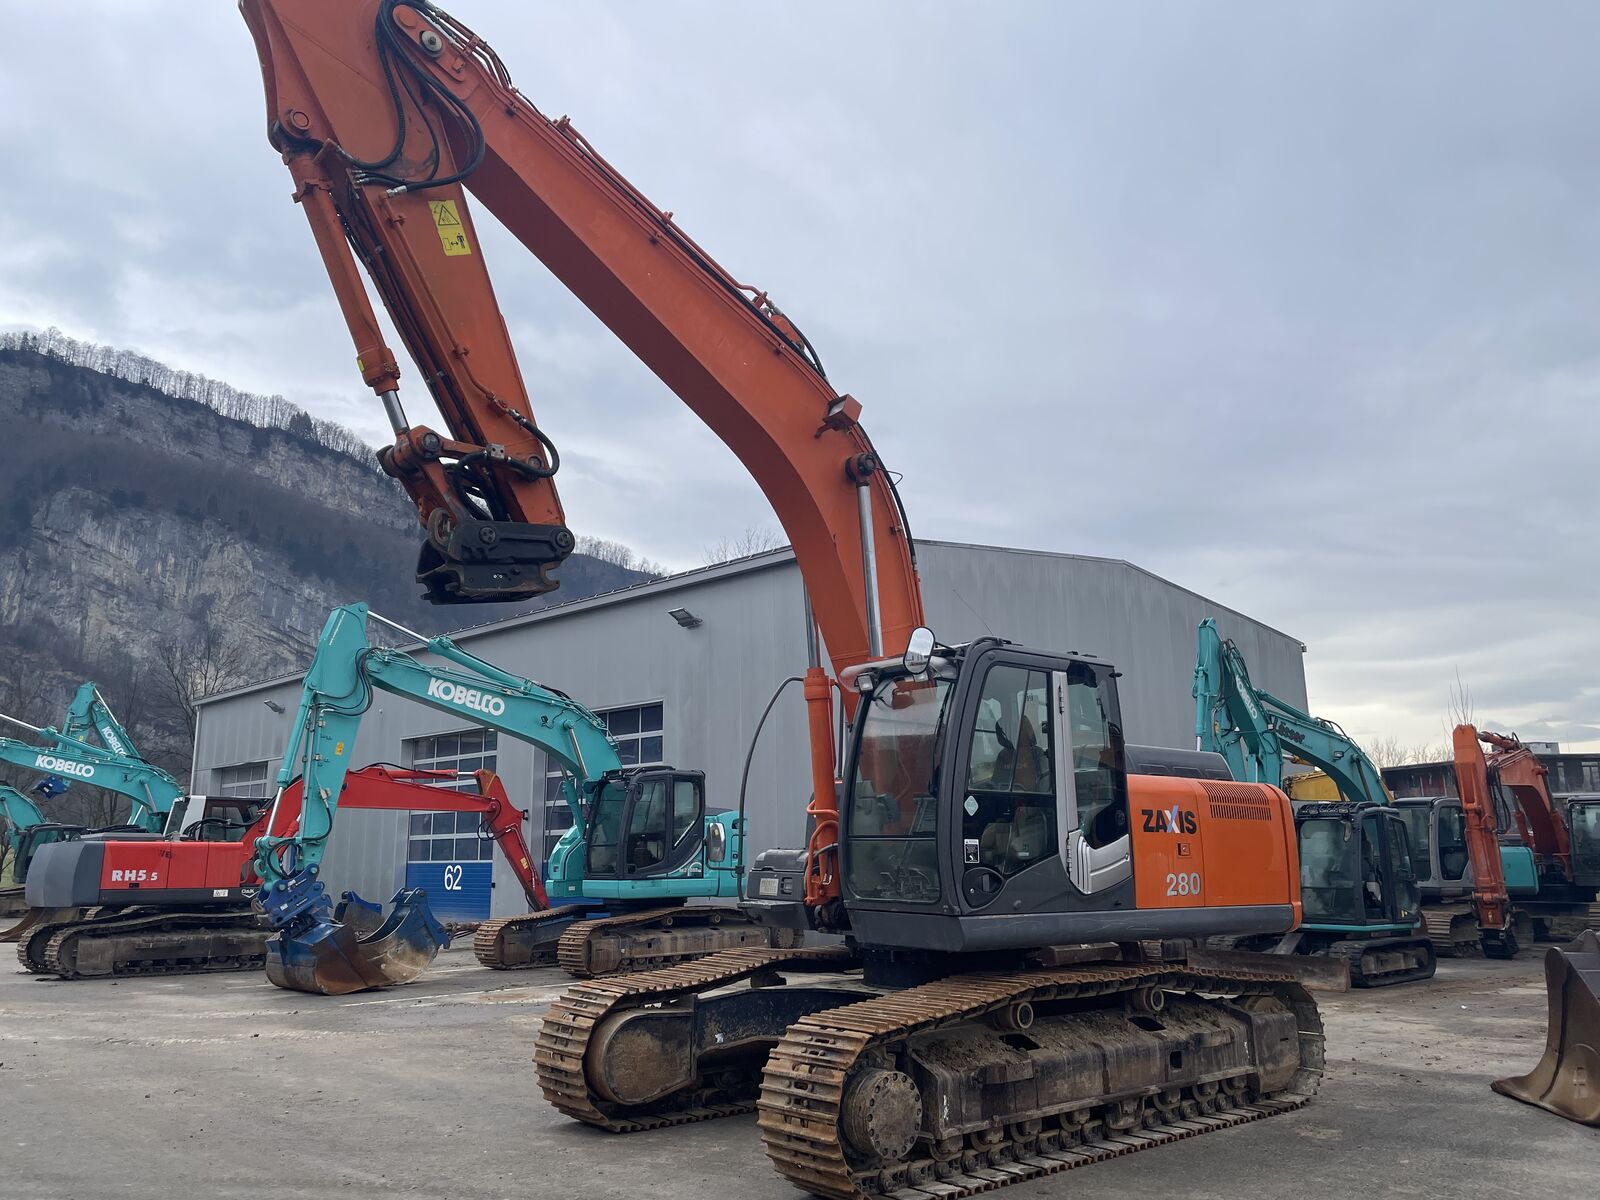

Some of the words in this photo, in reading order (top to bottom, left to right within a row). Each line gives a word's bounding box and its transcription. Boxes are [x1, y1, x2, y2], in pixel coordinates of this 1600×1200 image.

[427, 677, 506, 716] KOBELCO
[34, 754, 95, 778] KOBELCO
[1141, 803, 1198, 835] ZAXIS
[444, 864, 462, 890] 62
[1166, 872, 1201, 897] 280
